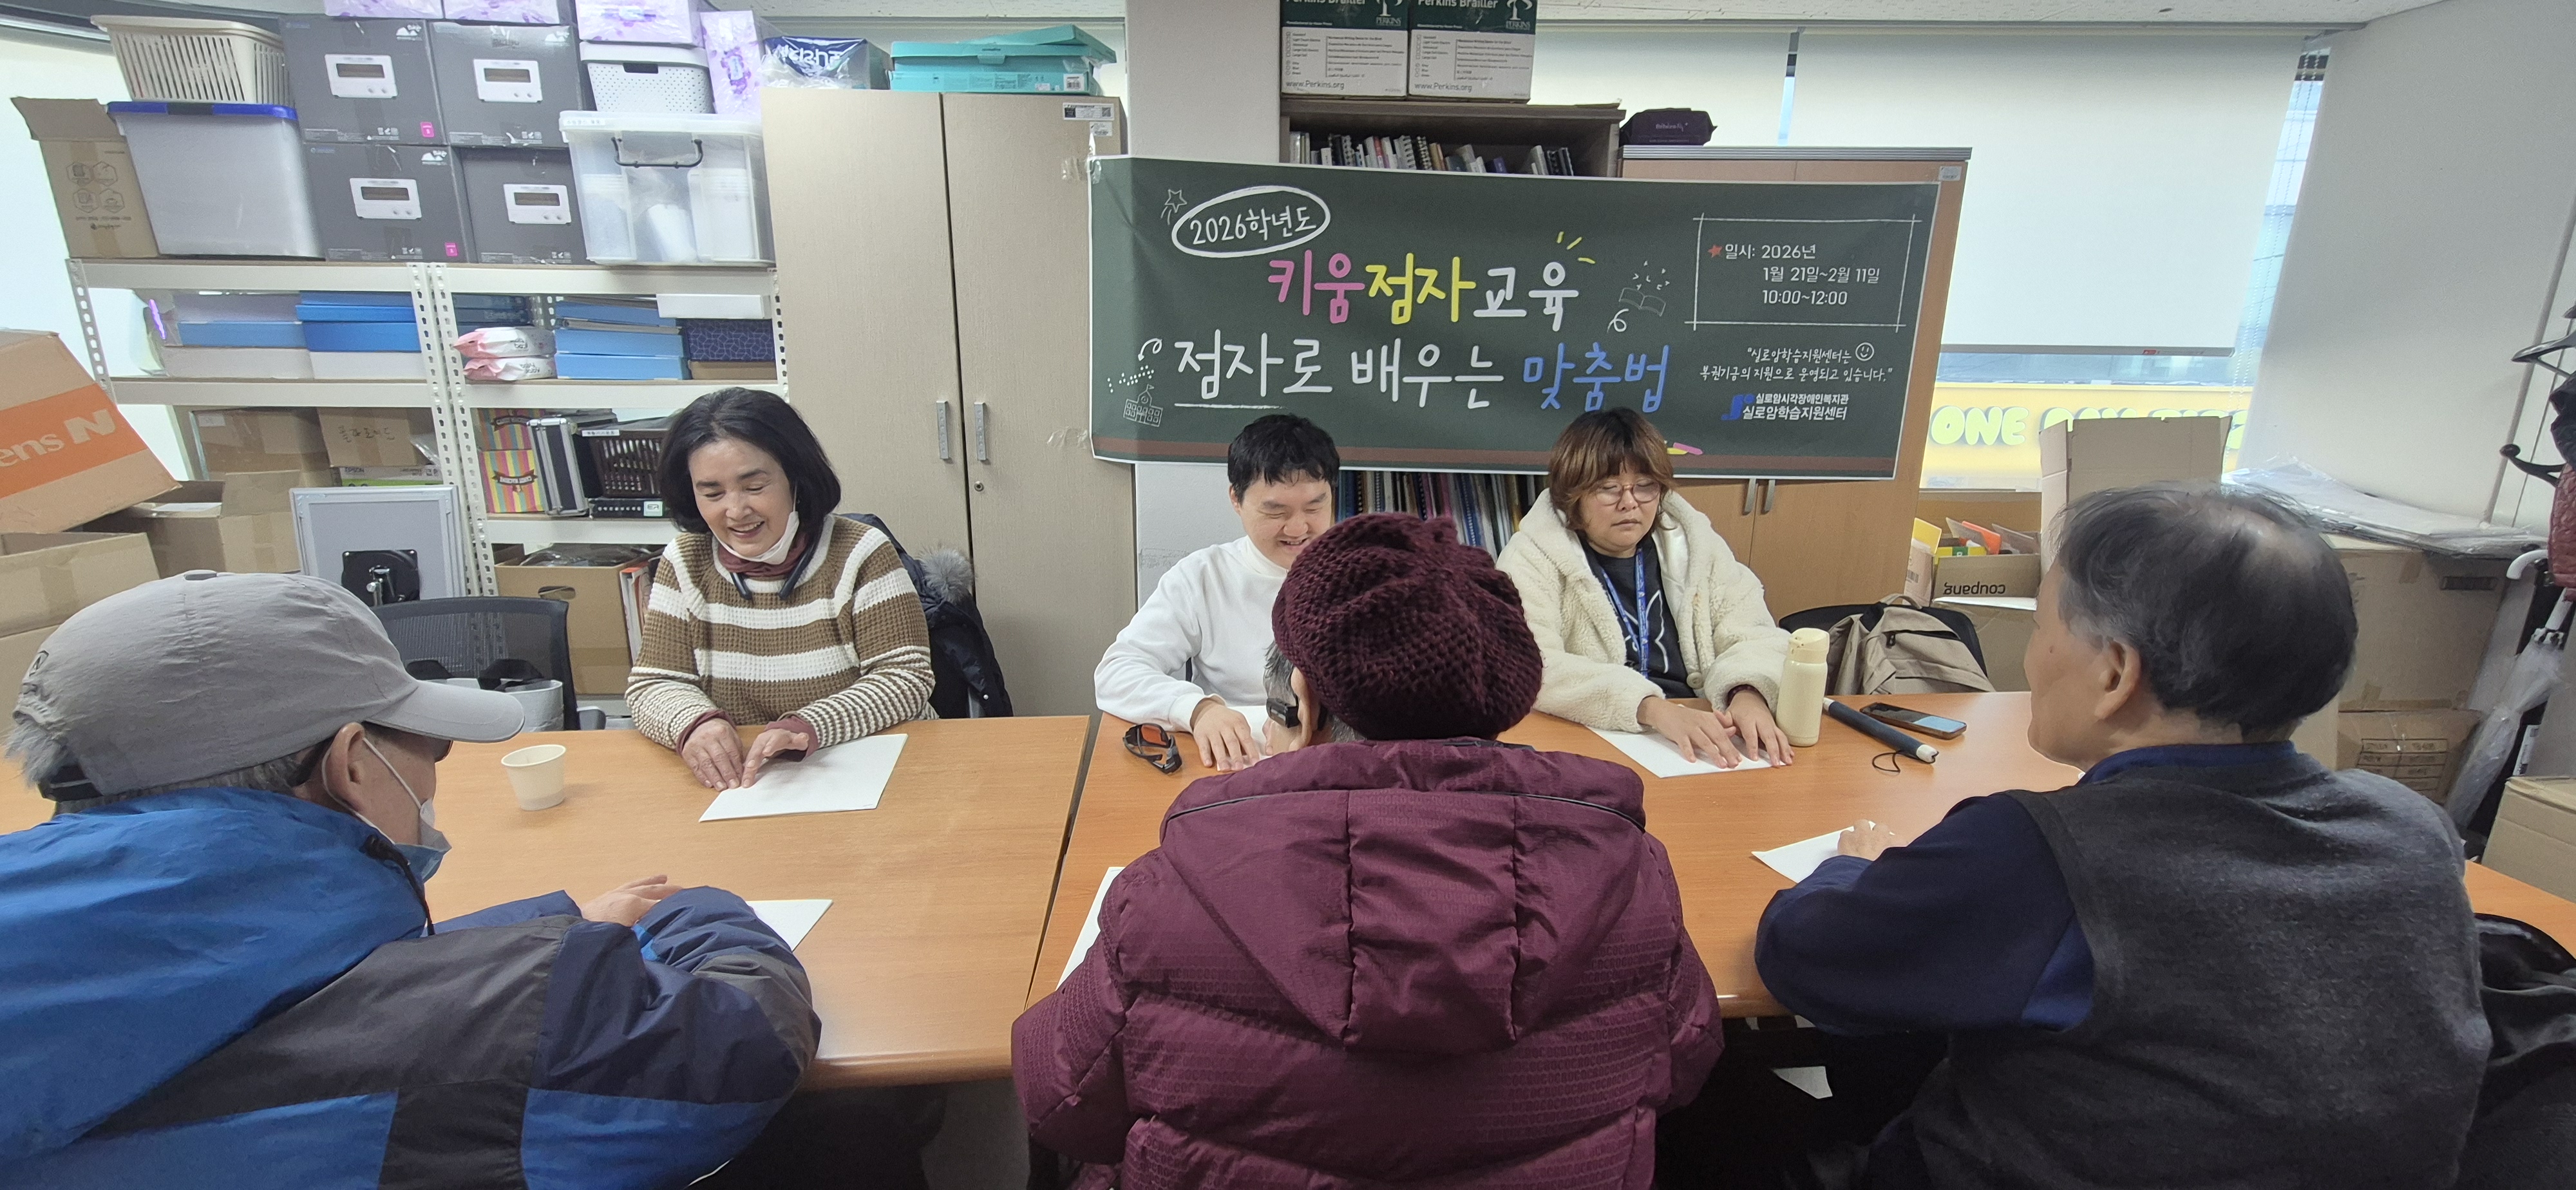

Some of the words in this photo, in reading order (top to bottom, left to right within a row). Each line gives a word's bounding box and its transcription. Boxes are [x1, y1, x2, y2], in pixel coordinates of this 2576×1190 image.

[1286, 80, 1345, 90] www.Perkins.org
[1414, 82, 1472, 93] www.Perkins.org
[1189, 205, 1317, 245] 2026학년도
[1725, 243, 1756, 260] 일시:
[1761, 243, 1816, 260] 2026년
[1763, 266, 1784, 282] 1월
[1790, 267, 1850, 283] 21일~2월
[1856, 268, 1880, 284] 11일
[1762, 290, 1848, 305] 10:00~12:00
[1174, 328, 1333, 400] 점자로
[1350, 338, 1504, 410] 배우는
[1523, 342, 1670, 413] 맞춤법
[1700, 365, 1751, 381] 복권기금의
[1754, 366, 1795, 381] 지원으로
[1799, 367, 1839, 382] 운영되고
[1756, 393, 1849, 405] 실로암시각장애인복지관
[1743, 405, 1848, 420] 실로암학습지원센터
[1930, 406, 2029, 446] ONE
[1942, 581, 2006, 595] coupang
